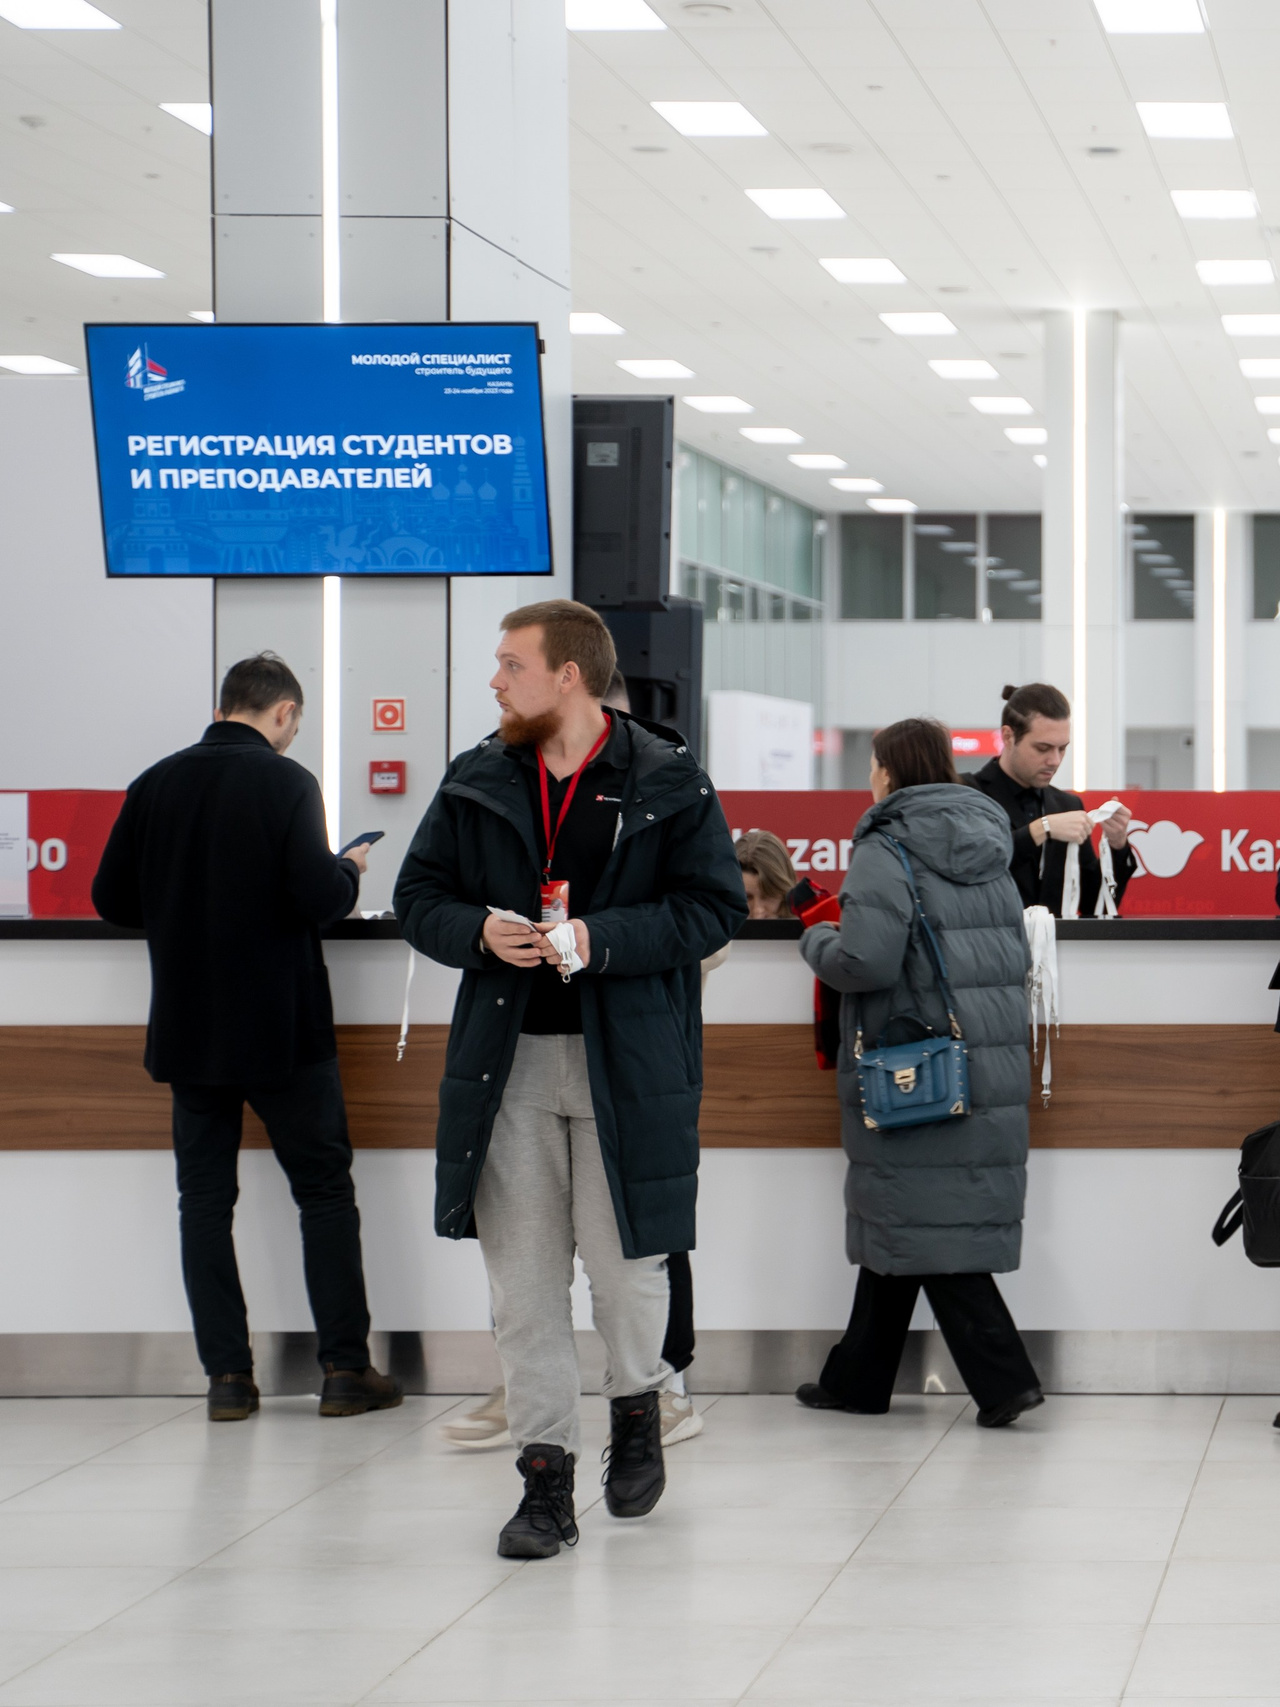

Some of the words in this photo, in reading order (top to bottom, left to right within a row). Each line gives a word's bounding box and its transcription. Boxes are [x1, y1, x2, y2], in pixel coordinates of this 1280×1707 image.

[351, 352, 421, 366] МОЛОДОЙ
[422, 353, 512, 366] СПЕЦИАЛИСТ
[415, 366, 465, 376] строитель
[465, 366, 513, 377] будущего
[127, 434, 336, 460] РЕГИСТРАЦИЯ
[341, 434, 513, 460] СТУДЕНТОВ
[130, 468, 153, 490] И
[159, 463, 433, 493] ПРЕПОДАВАТЕЛЕЙ
